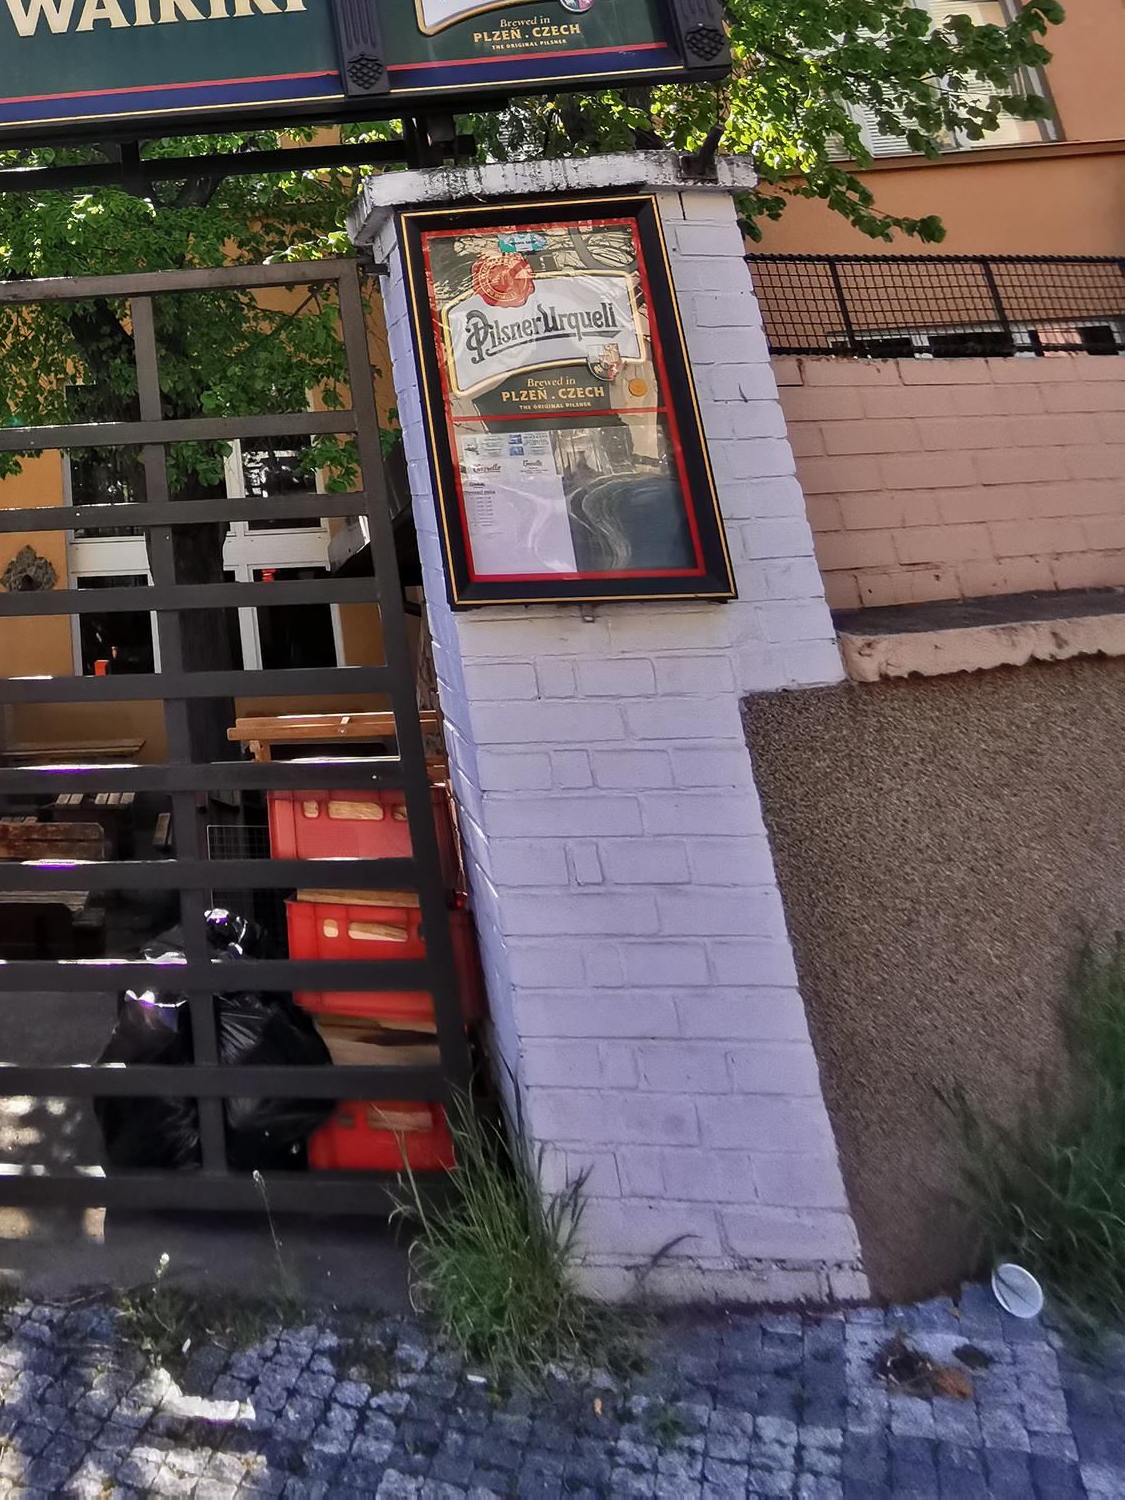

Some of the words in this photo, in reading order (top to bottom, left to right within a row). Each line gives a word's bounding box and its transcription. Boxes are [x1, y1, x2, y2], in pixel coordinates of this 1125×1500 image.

[500, 16, 537, 27] Brewed
[540, 15, 550, 24] in
[532, 23, 581, 37] CZECH
[465, 309, 542, 364] Pilsner
[527, 376, 563, 387] Brewed
[566, 375, 576, 385] in
[558, 386, 605, 399] CZECH
